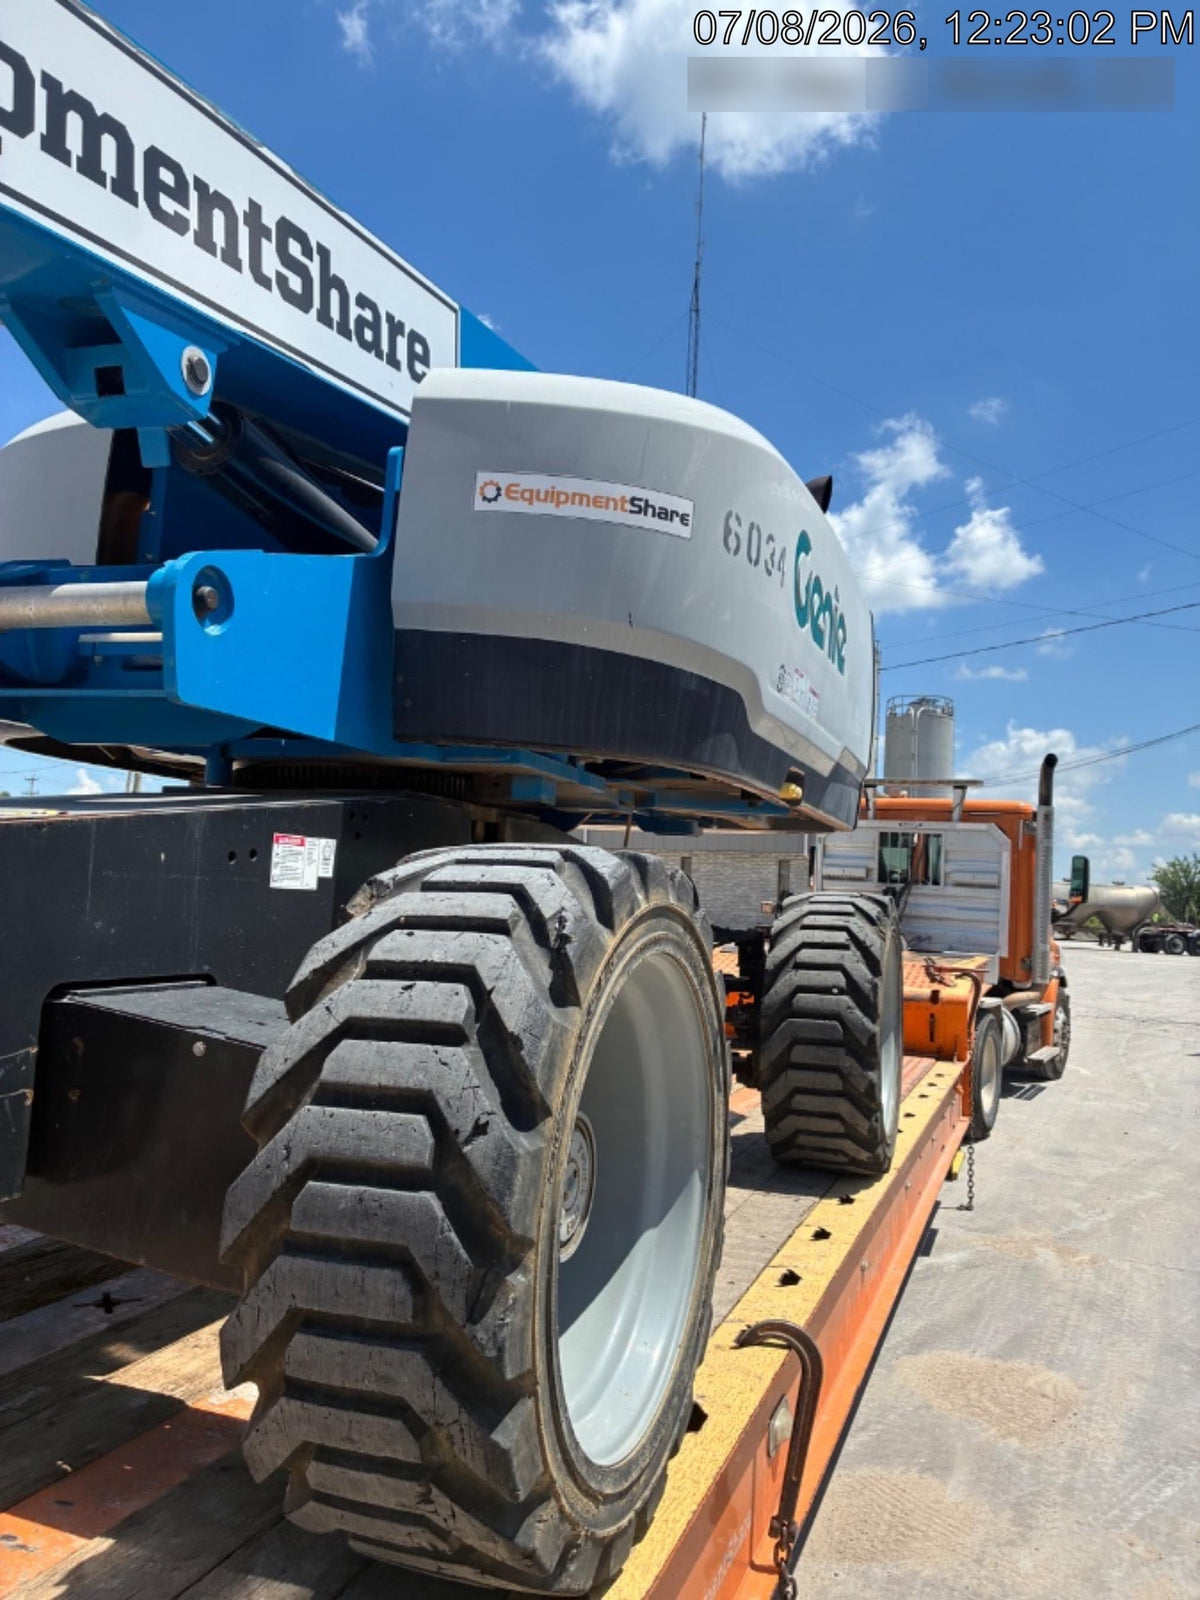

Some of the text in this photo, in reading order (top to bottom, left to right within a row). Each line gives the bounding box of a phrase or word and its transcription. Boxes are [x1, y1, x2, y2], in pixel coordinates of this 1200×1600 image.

[504, 482, 690, 527] EquipmentShare
[722, 509, 787, 588] 6034
[793, 528, 847, 676] Genie
